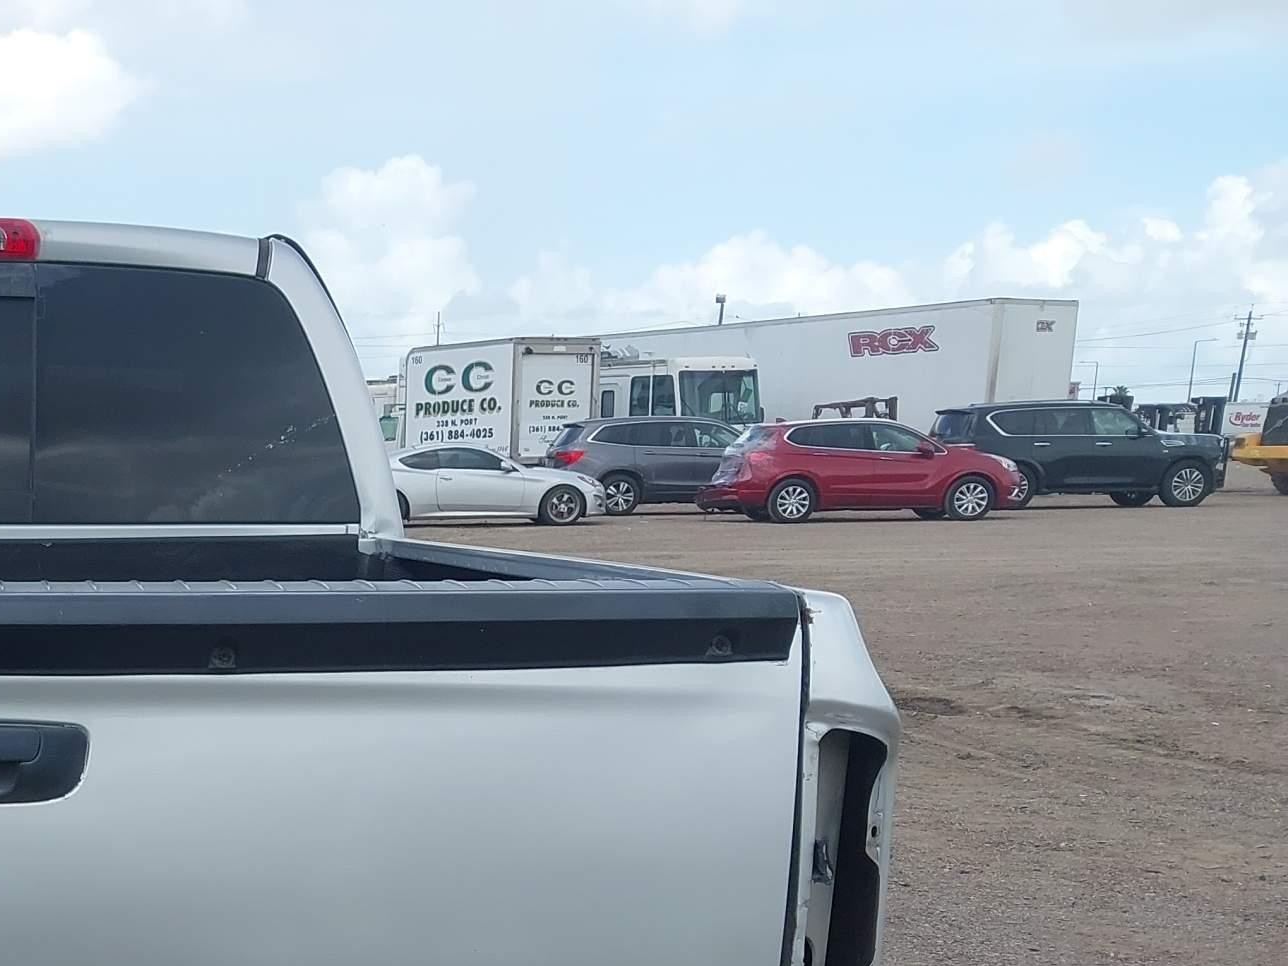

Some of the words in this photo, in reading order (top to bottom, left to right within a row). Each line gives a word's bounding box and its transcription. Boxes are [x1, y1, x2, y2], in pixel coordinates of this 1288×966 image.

[848, 325, 939, 357] RCX
[412, 356, 423, 364] 160
[576, 354, 589, 363] 160
[415, 399, 475, 416] PRODUCE
[479, 397, 502, 413] CO.
[529, 400, 564, 408] PRODUCE
[420, 431, 444, 445] (361)
[447, 428, 494, 440] 884-4025
